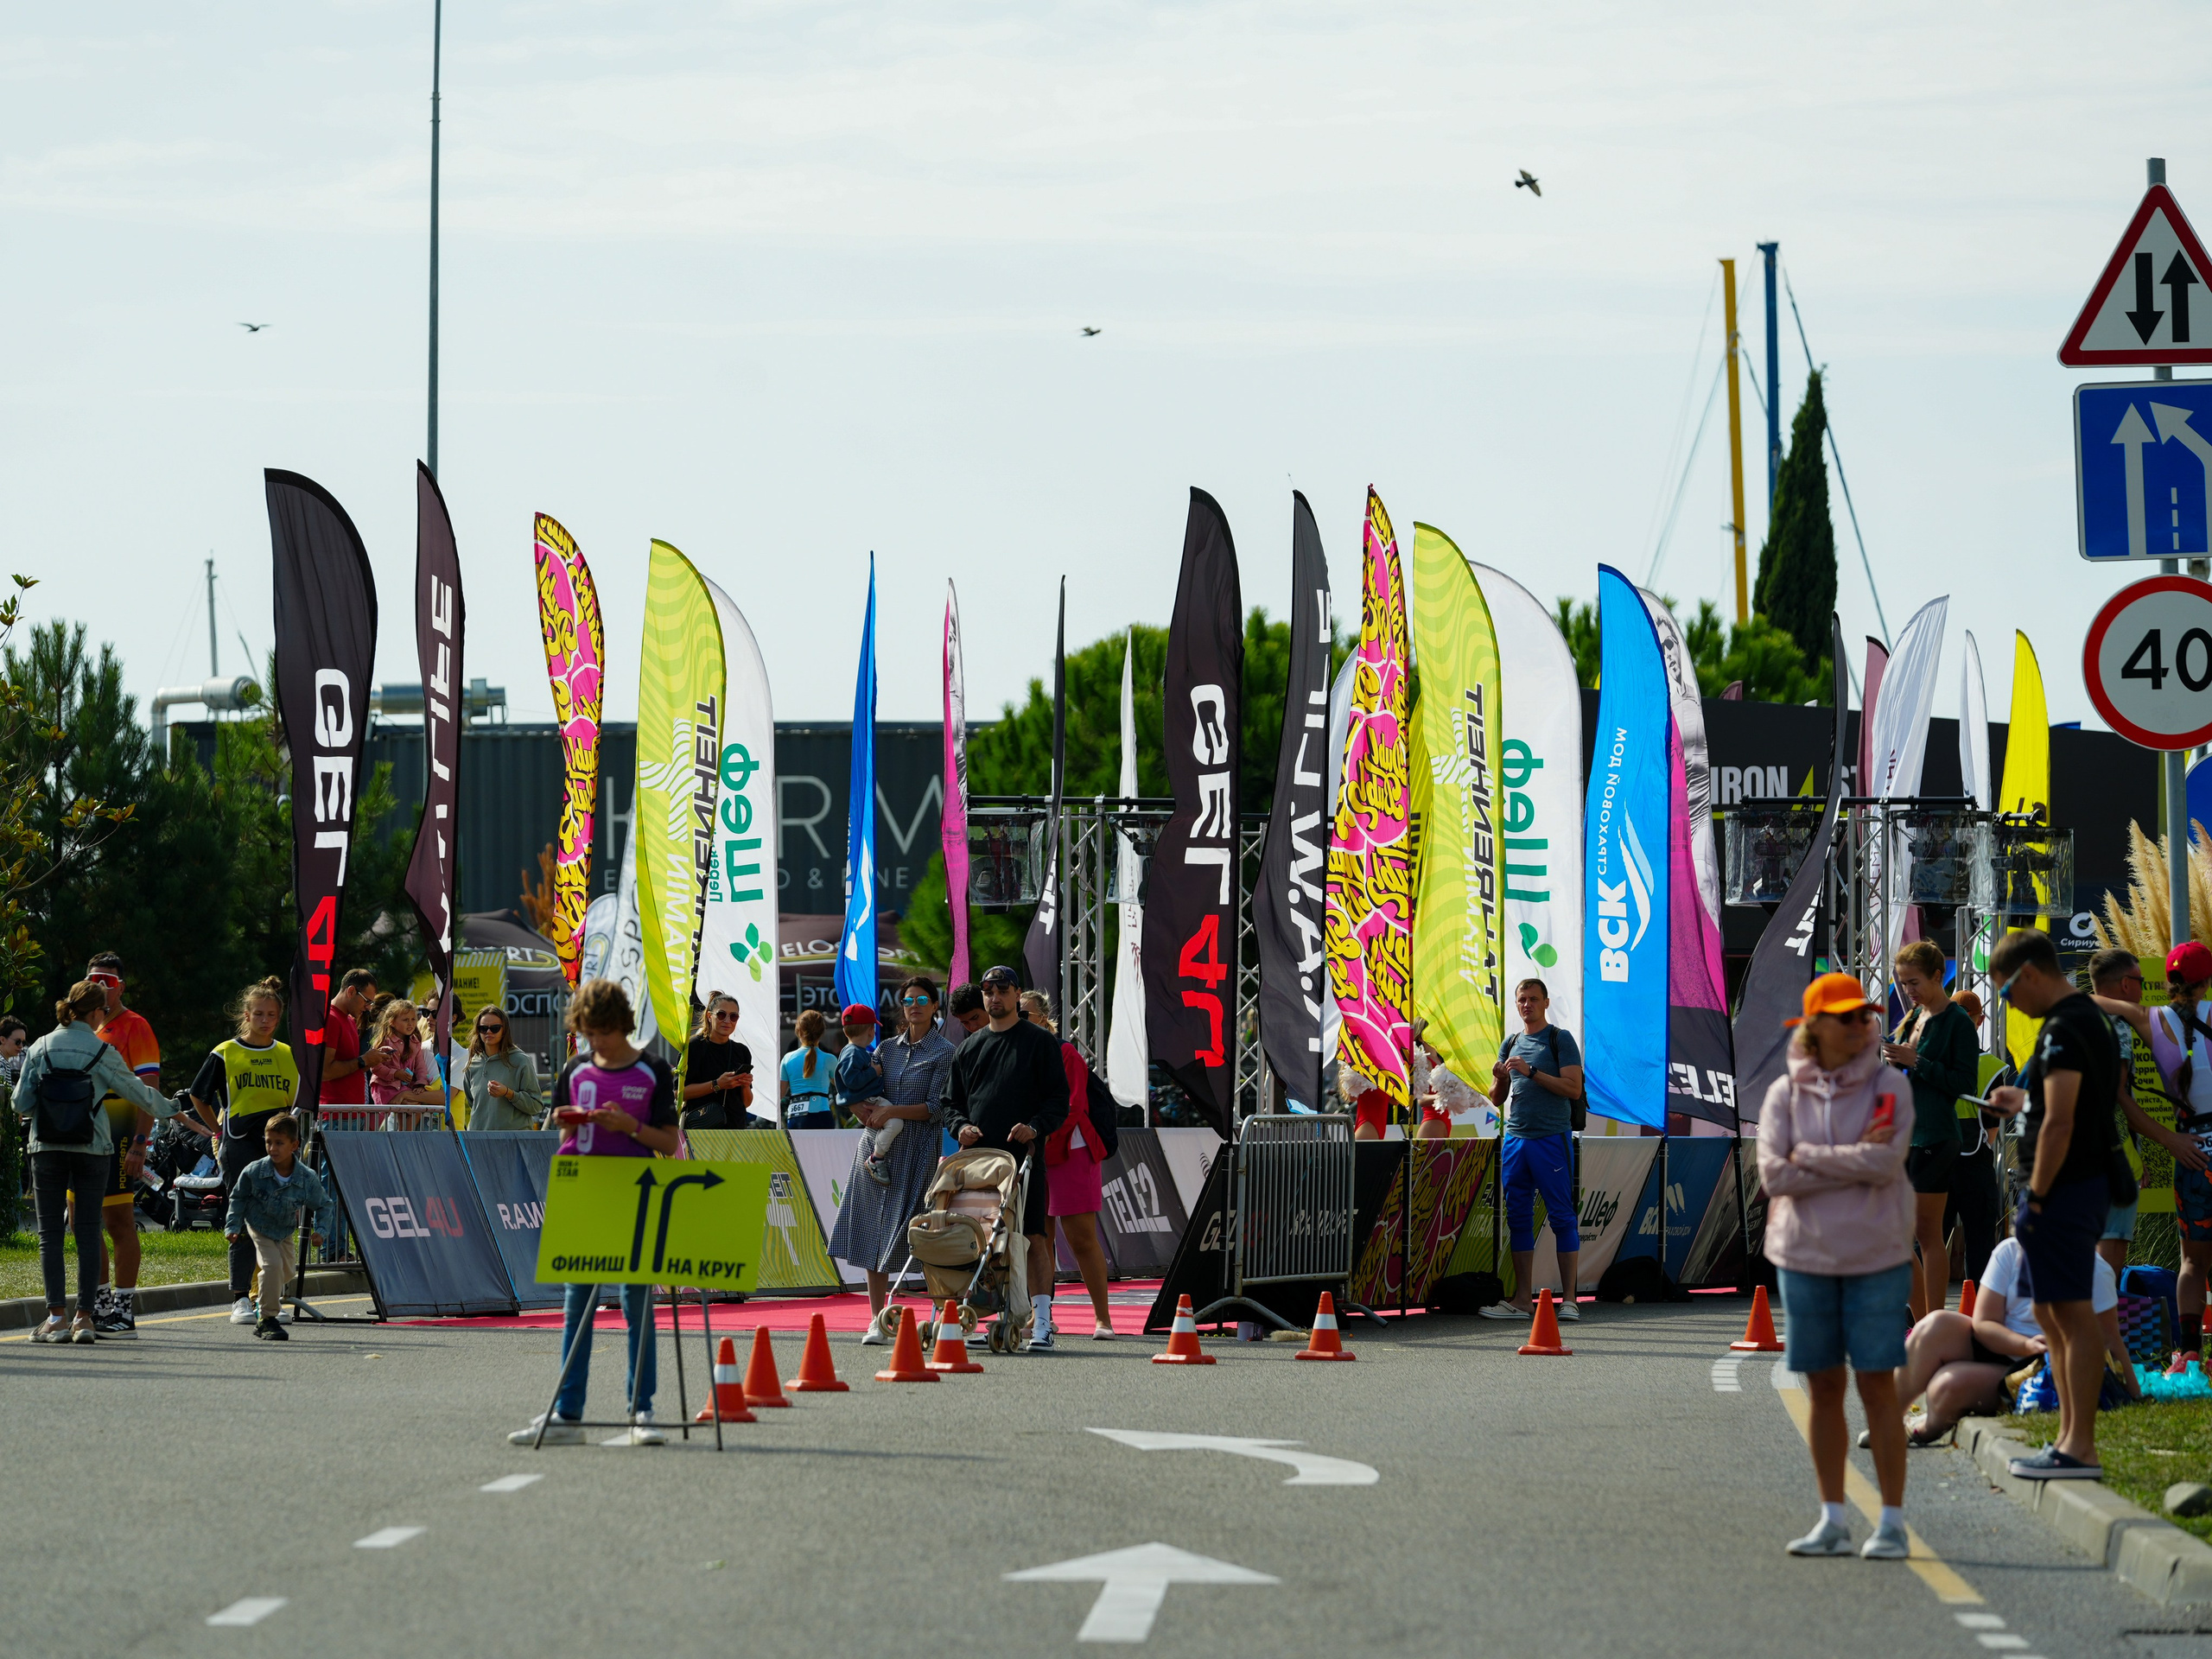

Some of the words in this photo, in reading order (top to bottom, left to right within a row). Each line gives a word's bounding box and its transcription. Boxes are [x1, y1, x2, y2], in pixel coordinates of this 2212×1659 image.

[2120, 627, 2212, 692] 40
[1709, 766, 1788, 804] IRON
[453, 977, 480, 988] МАНИЕ!
[365, 1197, 464, 1239] GEL4U
[1102, 1162, 1173, 1234] TELE2
[1580, 1191, 1621, 1236] Шеф
[551, 1256, 625, 1271] ФИНИШ
[667, 1258, 692, 1274] НА
[698, 1261, 746, 1279] КРУГ
